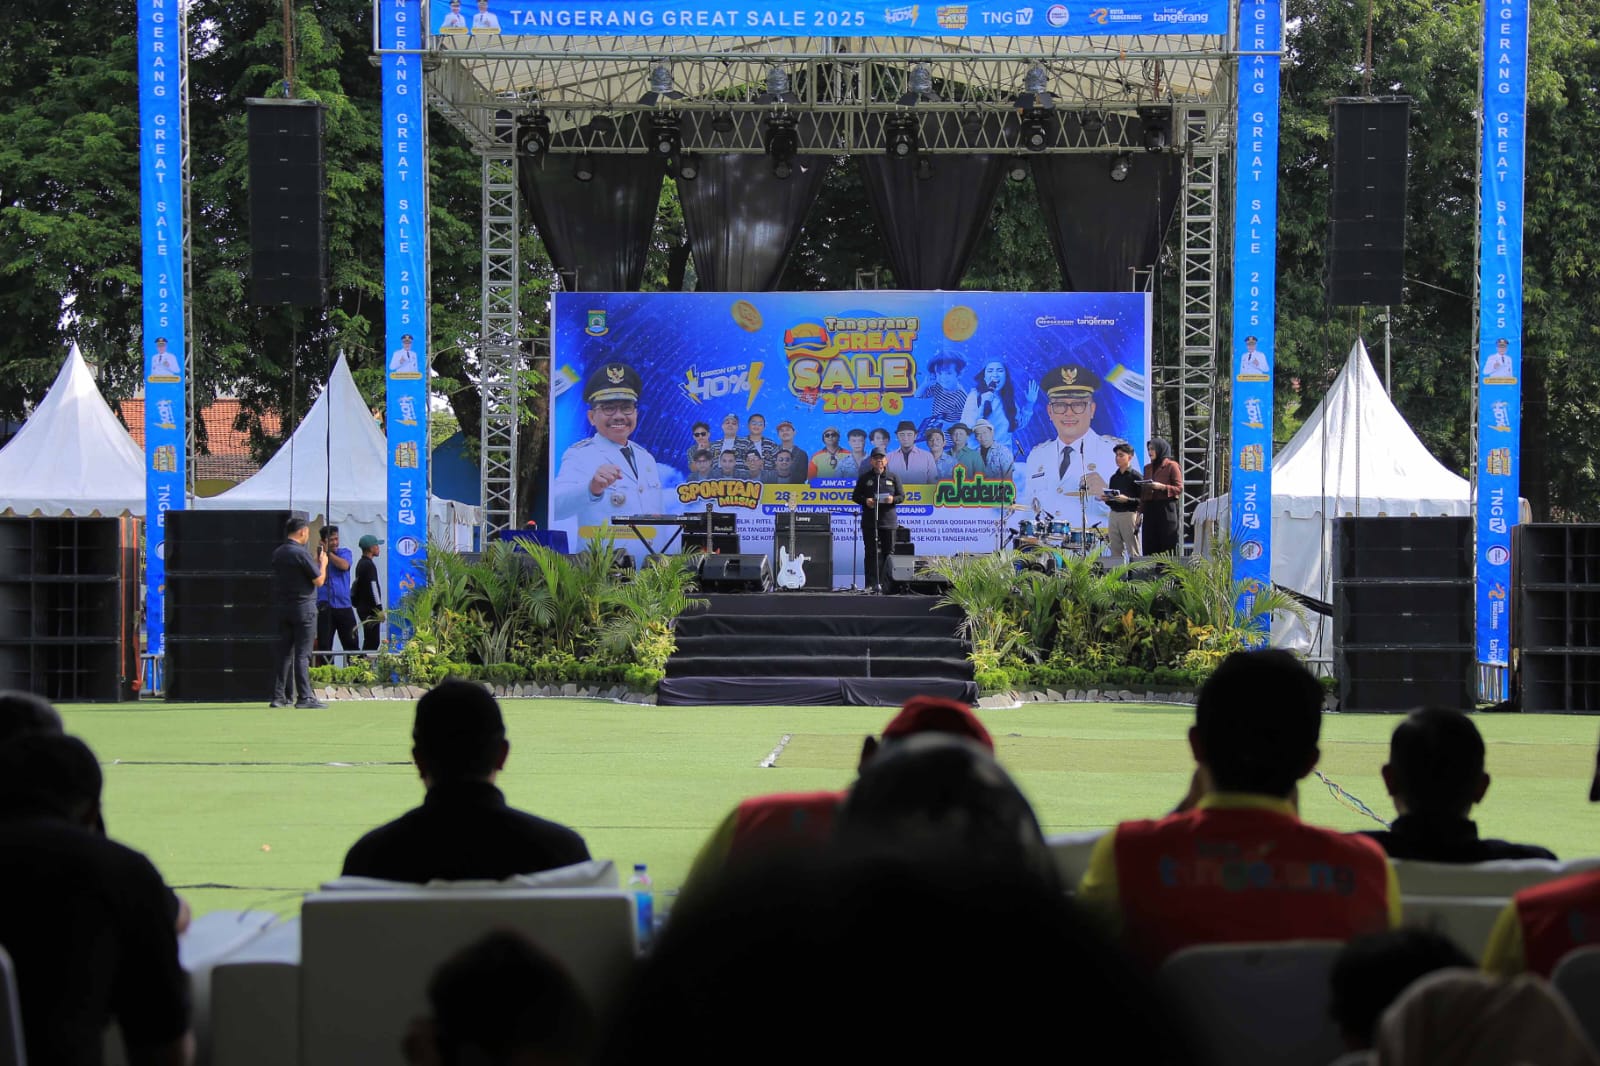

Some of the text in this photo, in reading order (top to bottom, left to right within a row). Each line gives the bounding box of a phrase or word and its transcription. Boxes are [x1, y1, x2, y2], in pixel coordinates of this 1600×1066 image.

[510, 10, 865, 27] TANGERANG GREAT SALE 2025
[982, 12, 1013, 24] TNG
[1153, 11, 1208, 23] tangerang
[1252, 112, 1263, 181] GREAT
[1497, 112, 1508, 182] GREAT
[153, 0, 168, 327] NGERANG GREAT SALE 2025
[395, 0, 410, 324] NGERANG GREAT SALE 2025
[1251, 199, 1261, 254] SALE
[1496, 200, 1507, 256] SALE
[1250, 271, 1259, 325] 2025
[1497, 274, 1505, 329] 2025
[825, 318, 918, 332] Tangerang
[834, 331, 916, 351] GREAT
[792, 355, 912, 391] SALE
[823, 392, 881, 412] 2025
[400, 480, 411, 508] TNG
[678, 481, 761, 502] SPONTAN
[719, 495, 757, 509] MUSIC
[774, 491, 922, 501] 28 29 NOVE 25
[1244, 484, 1256, 511] TNG
[1490, 487, 1503, 516] TNG
